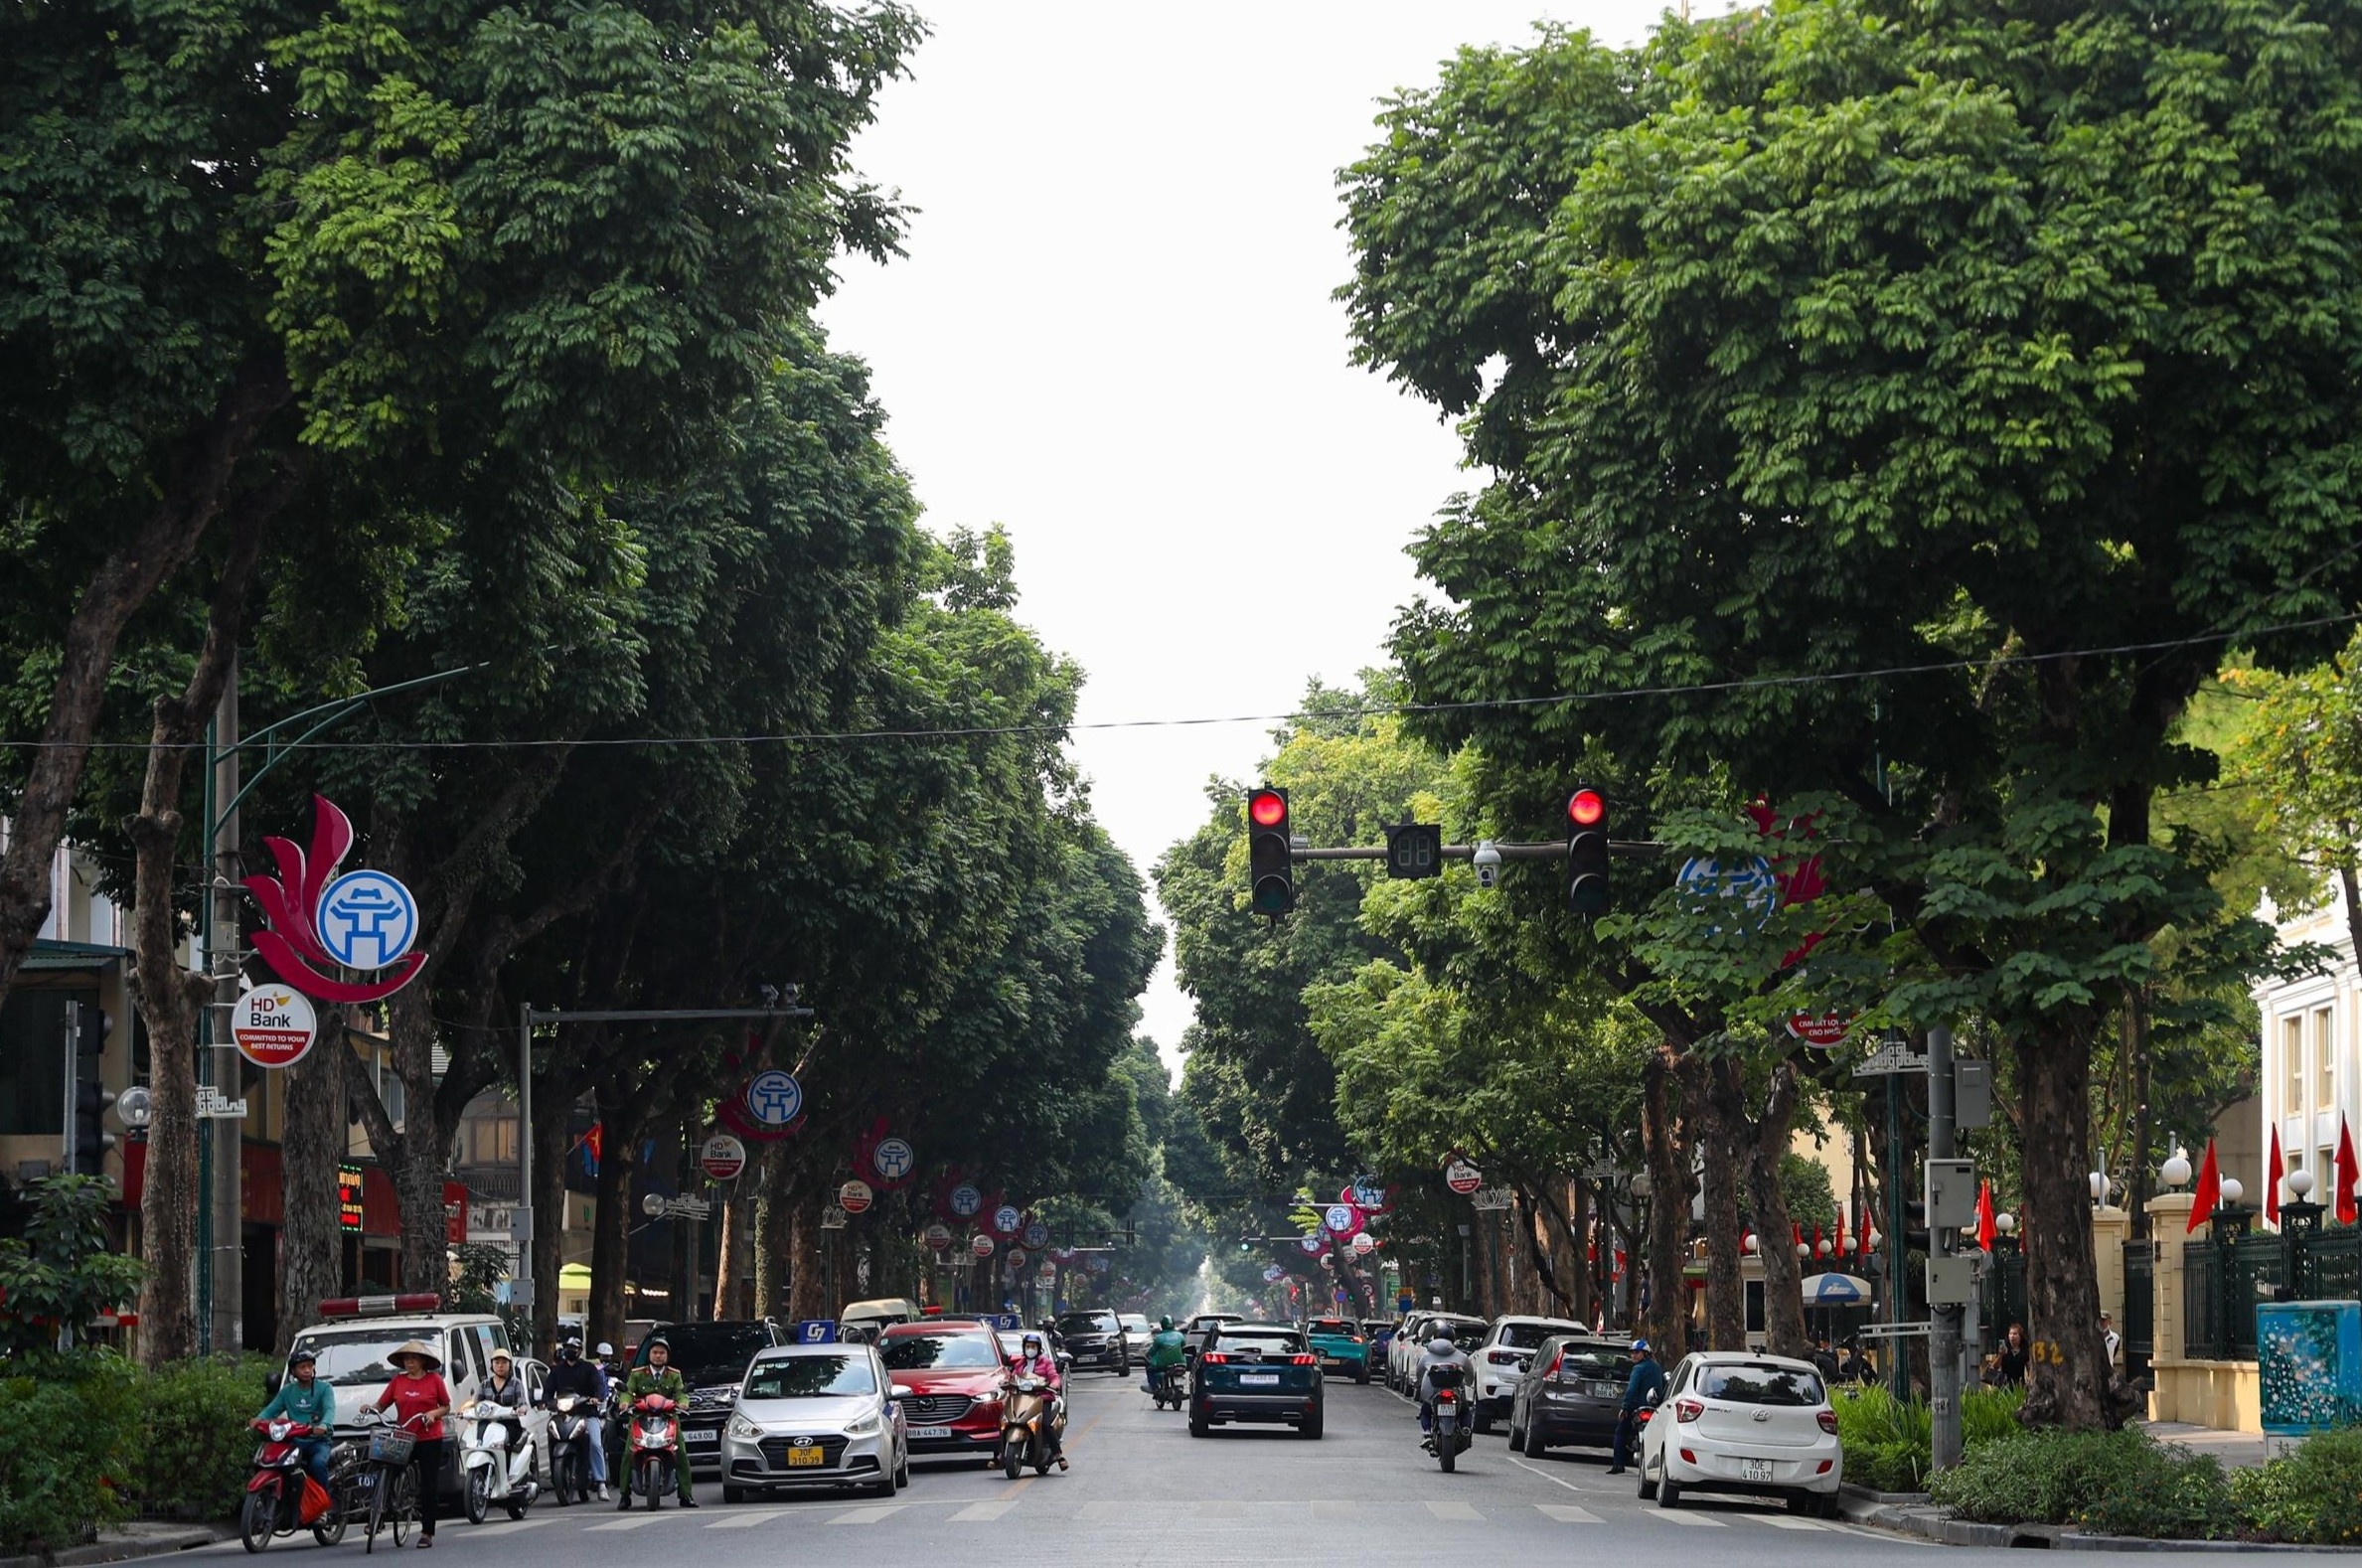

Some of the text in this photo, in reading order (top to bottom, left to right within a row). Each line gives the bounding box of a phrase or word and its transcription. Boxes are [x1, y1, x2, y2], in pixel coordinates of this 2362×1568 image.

[250, 998, 275, 1012] HD
[250, 1013, 291, 1027] Bank
[710, 1150, 732, 1159] Bank
[1749, 1460, 1766, 1471] 30E
